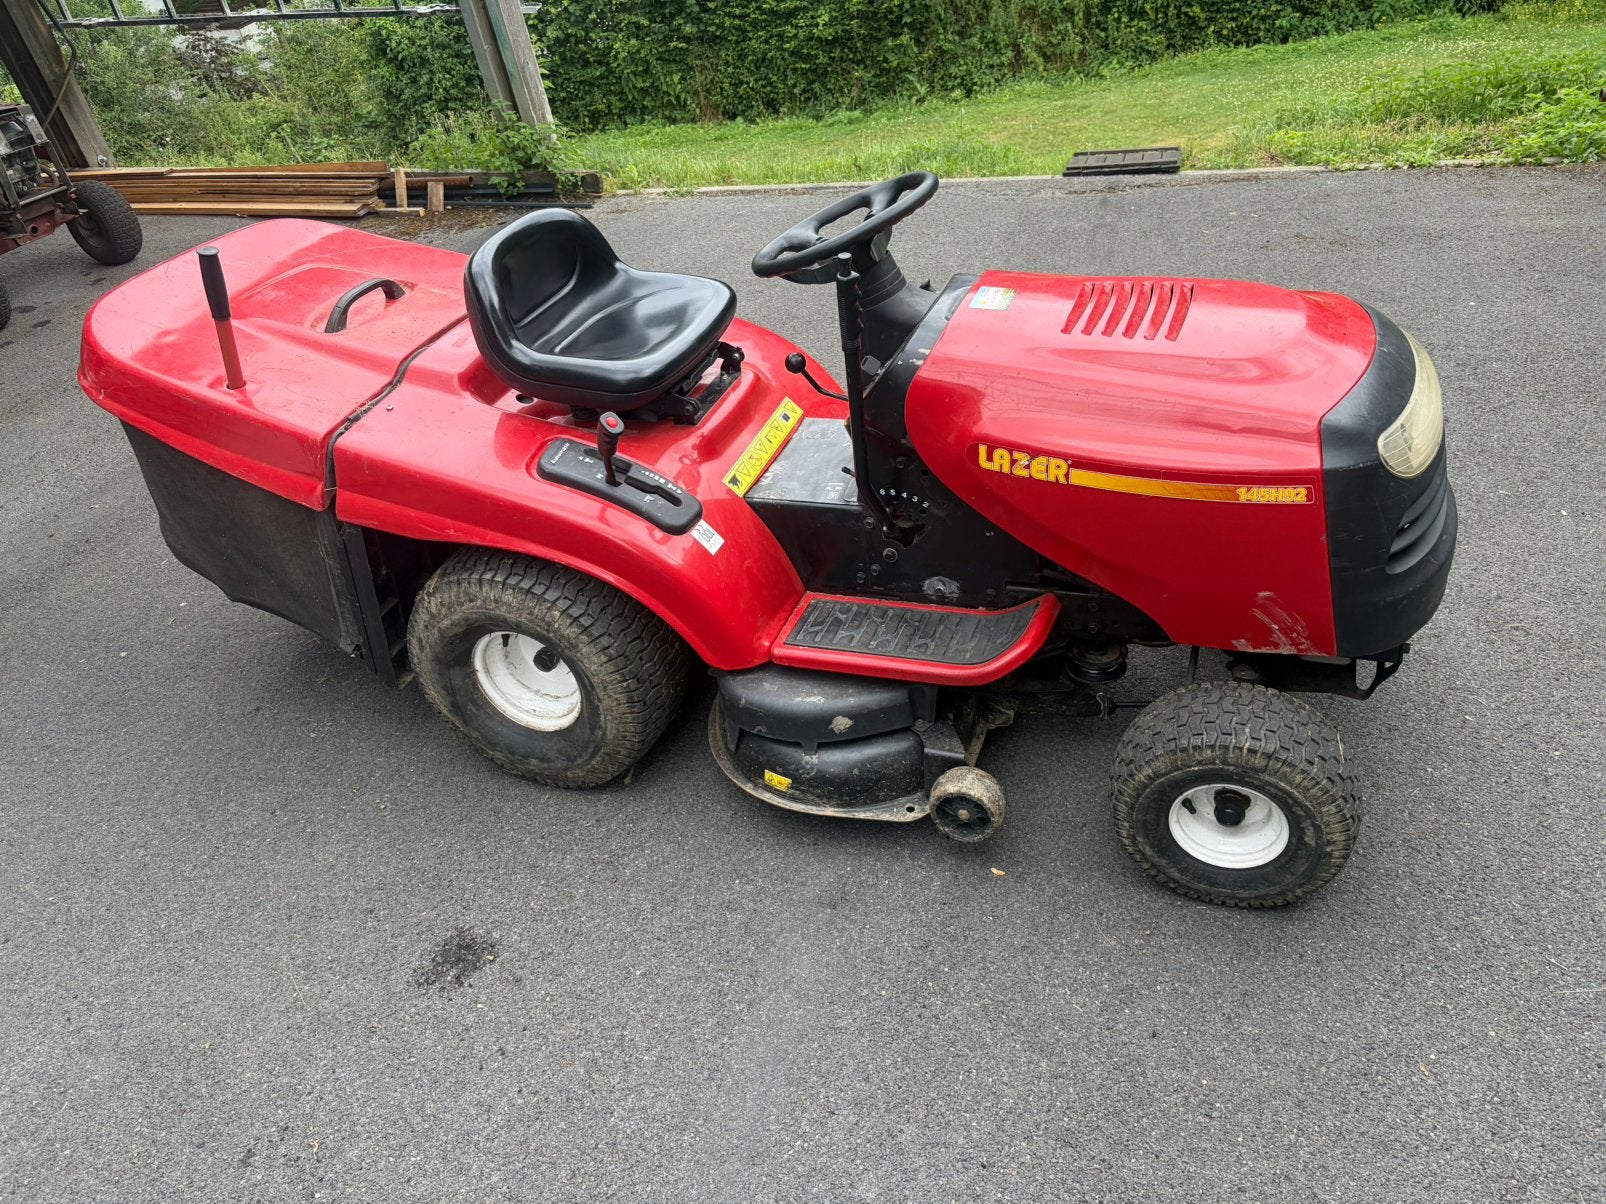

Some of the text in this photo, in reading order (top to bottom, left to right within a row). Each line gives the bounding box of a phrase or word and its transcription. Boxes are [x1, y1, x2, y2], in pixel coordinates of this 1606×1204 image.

[978, 444, 1068, 485] LAZER
[879, 488, 886, 496] 6
[889, 488, 896, 496] 5
[901, 491, 908, 499] 4
[1236, 486, 1308, 502] 145H92
